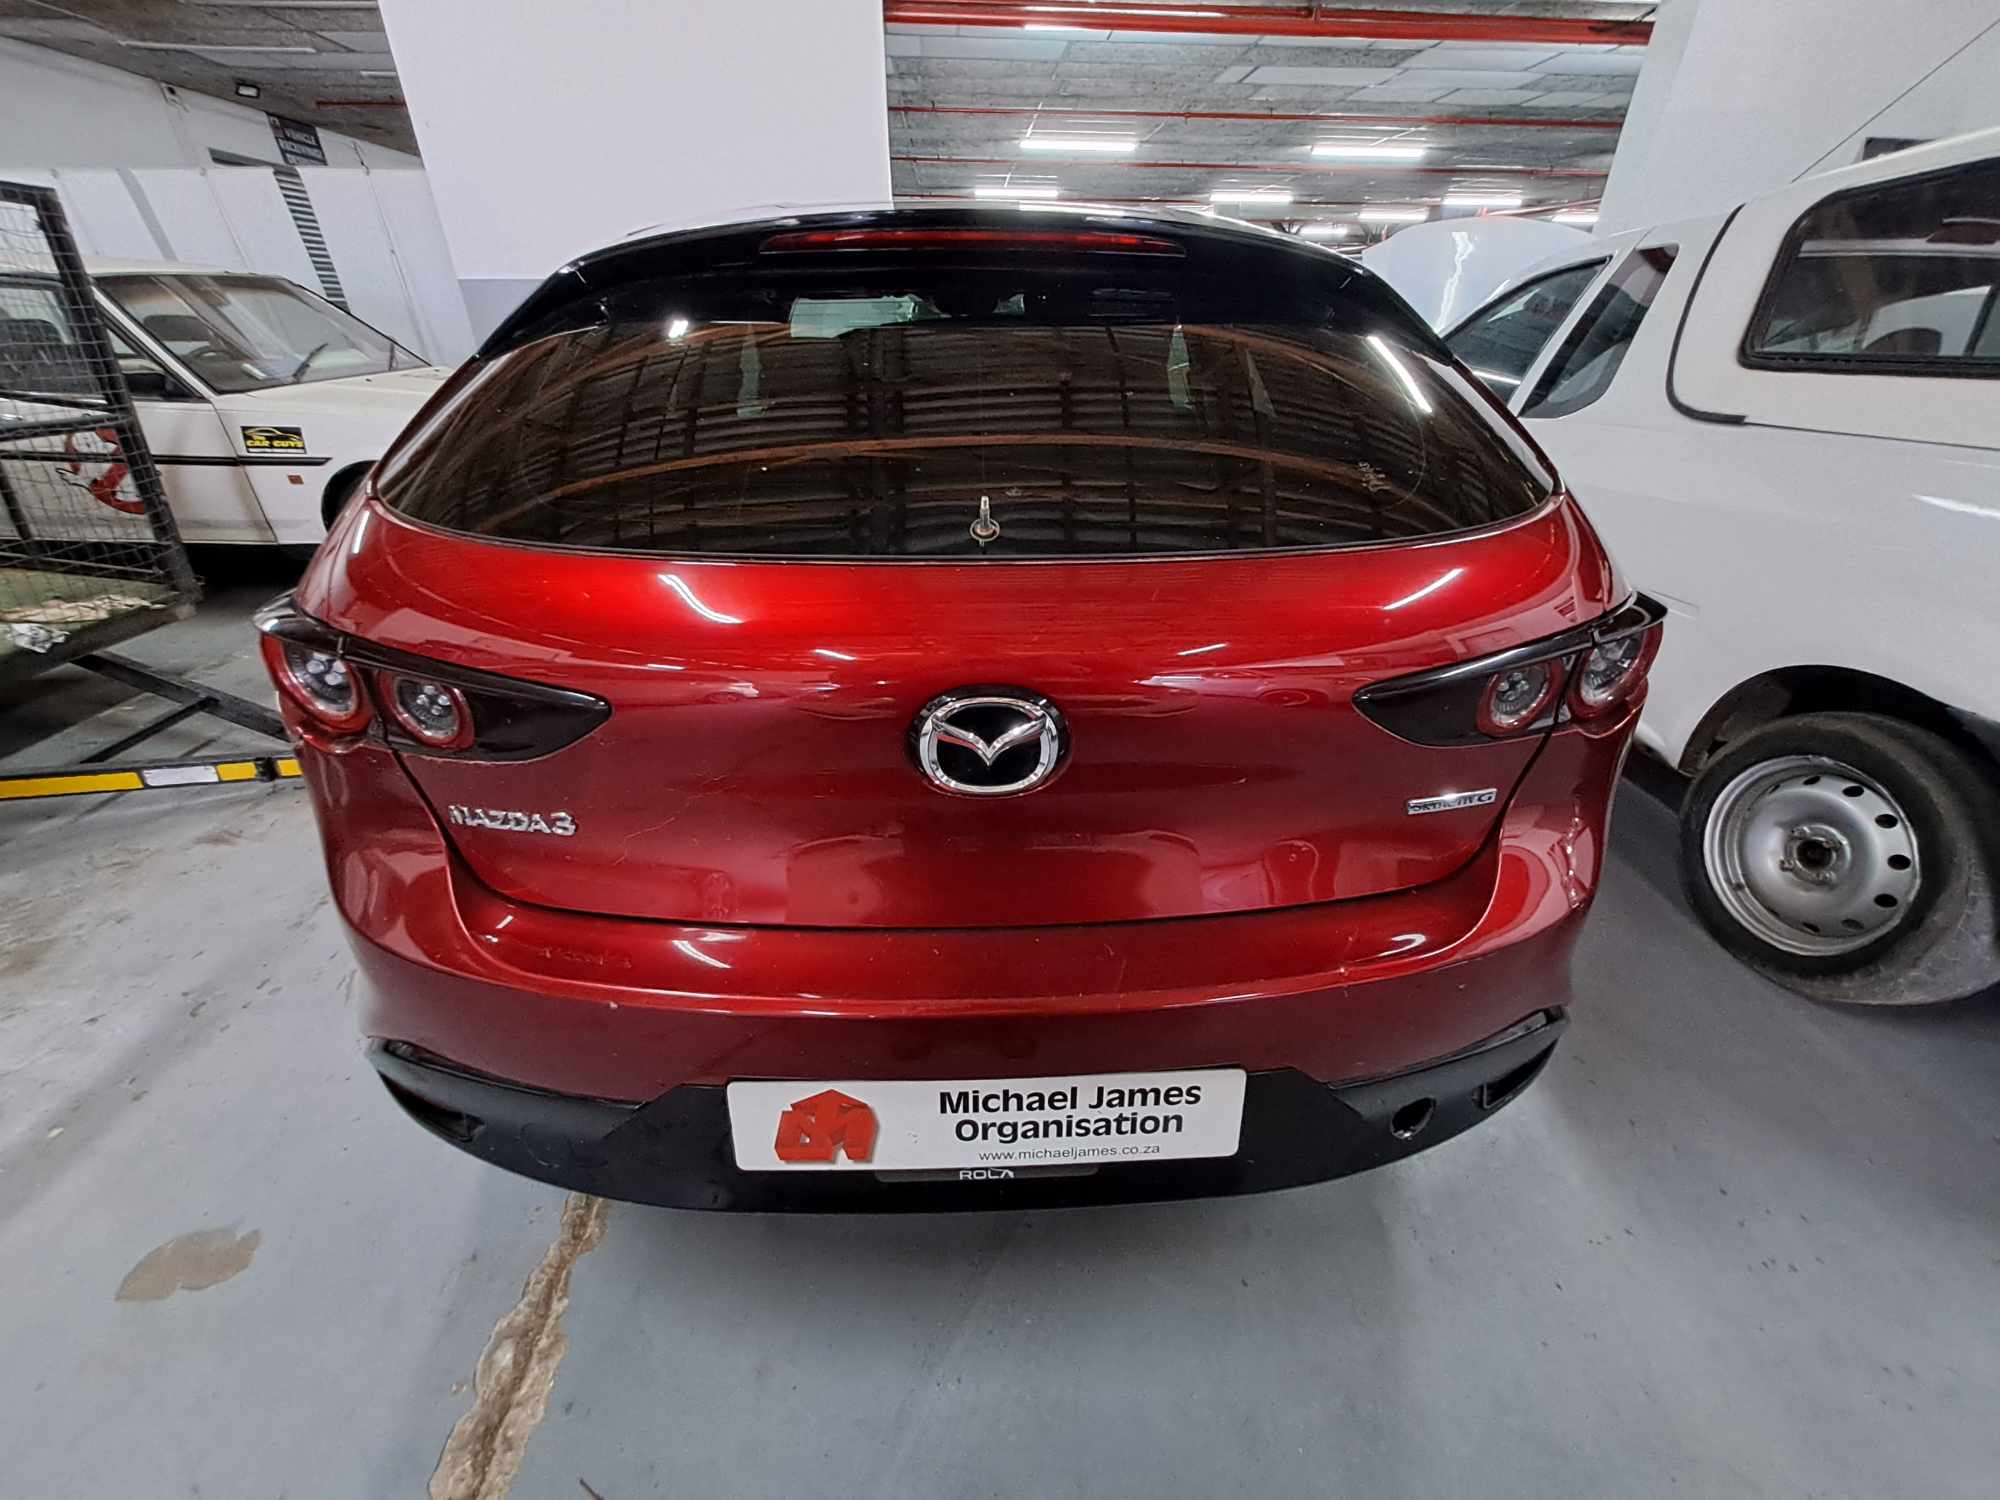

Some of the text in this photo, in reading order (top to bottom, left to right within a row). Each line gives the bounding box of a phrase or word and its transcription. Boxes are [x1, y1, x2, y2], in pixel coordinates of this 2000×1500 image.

[246, 440, 271, 448] CAR
[939, 1084, 1202, 1115] Michael James
[954, 1111, 1184, 1144] Organisation
[978, 1144, 1161, 1162] www.michaeljames.co.za
[959, 1167, 1015, 1181] ROLA
